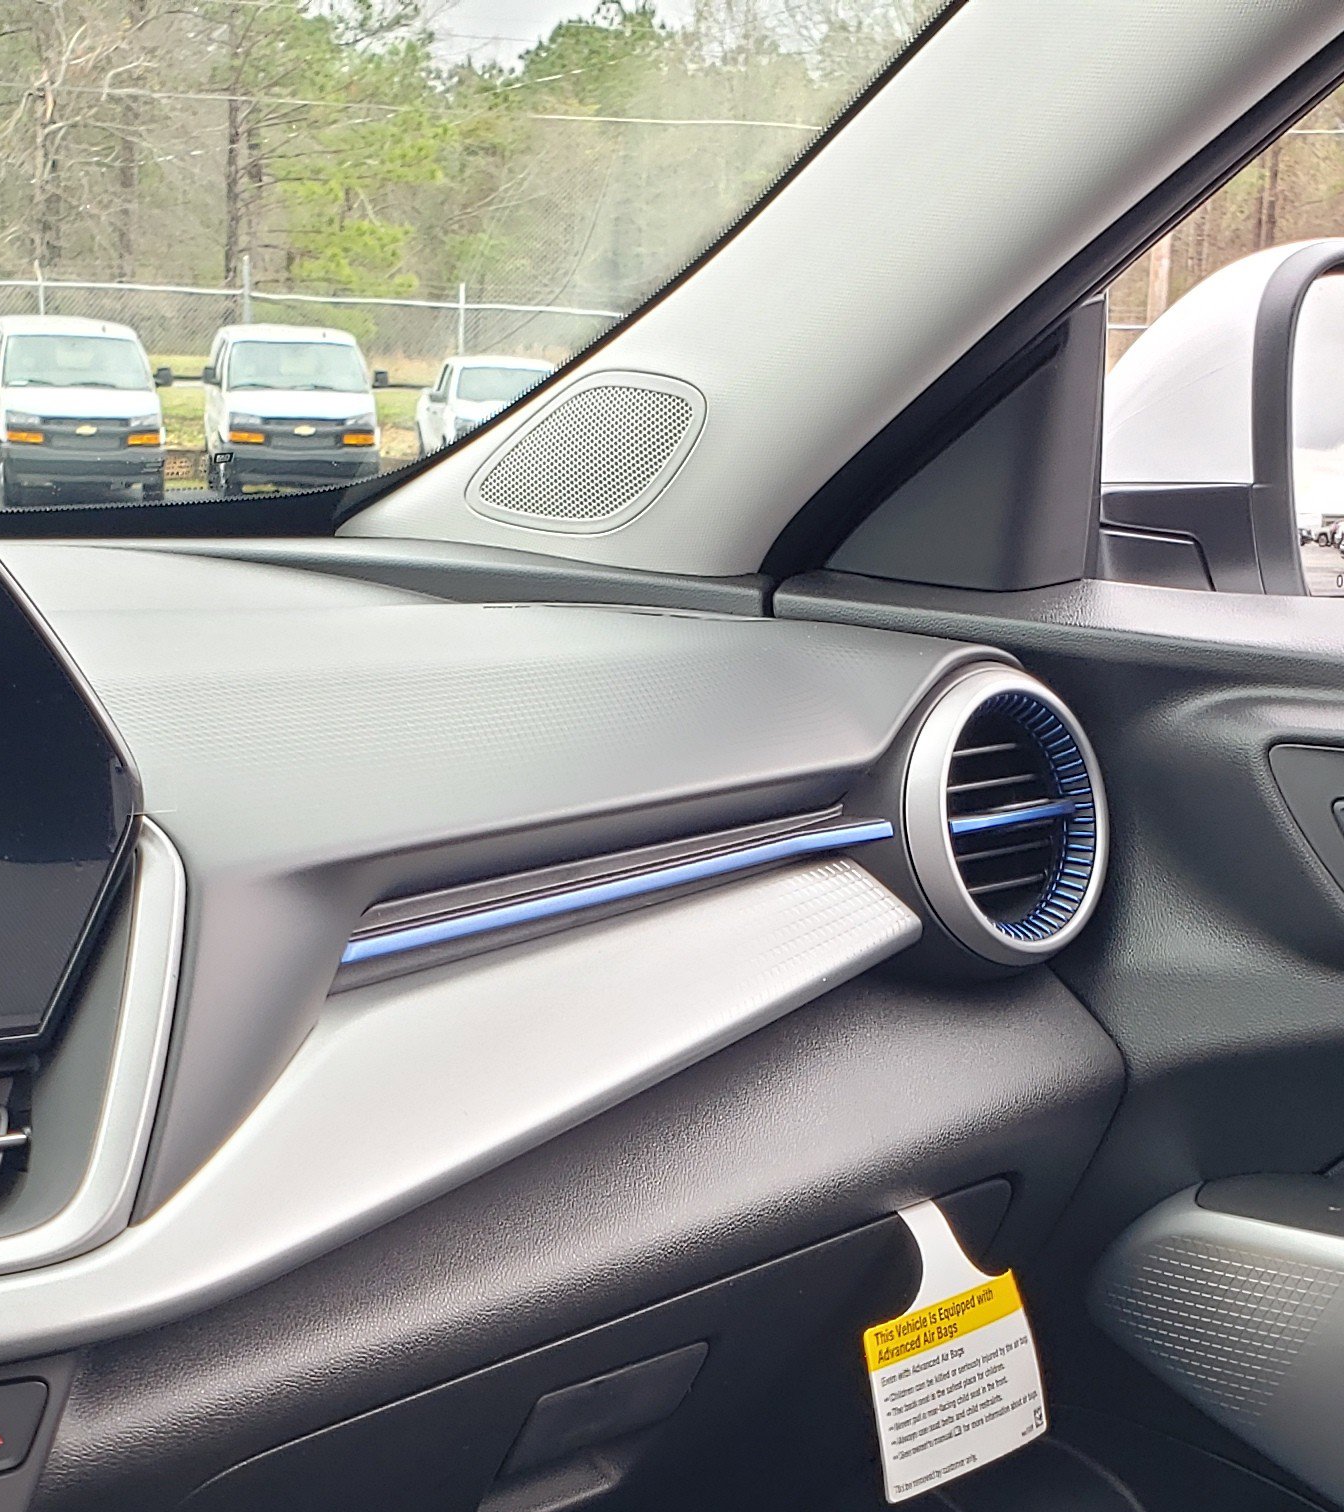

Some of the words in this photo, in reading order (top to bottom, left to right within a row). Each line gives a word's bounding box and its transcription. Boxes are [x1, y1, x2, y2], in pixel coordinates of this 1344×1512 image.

[874, 1328, 895, 1346] This
[895, 1316, 928, 1338] Vehicle
[928, 1312, 937, 1325] is
[938, 1294, 976, 1321] Equipped
[976, 1288, 993, 1305] with
[878, 1334, 921, 1364] Advanced
[923, 1330, 935, 1346] Air
[936, 1322, 958, 1340] Bags
